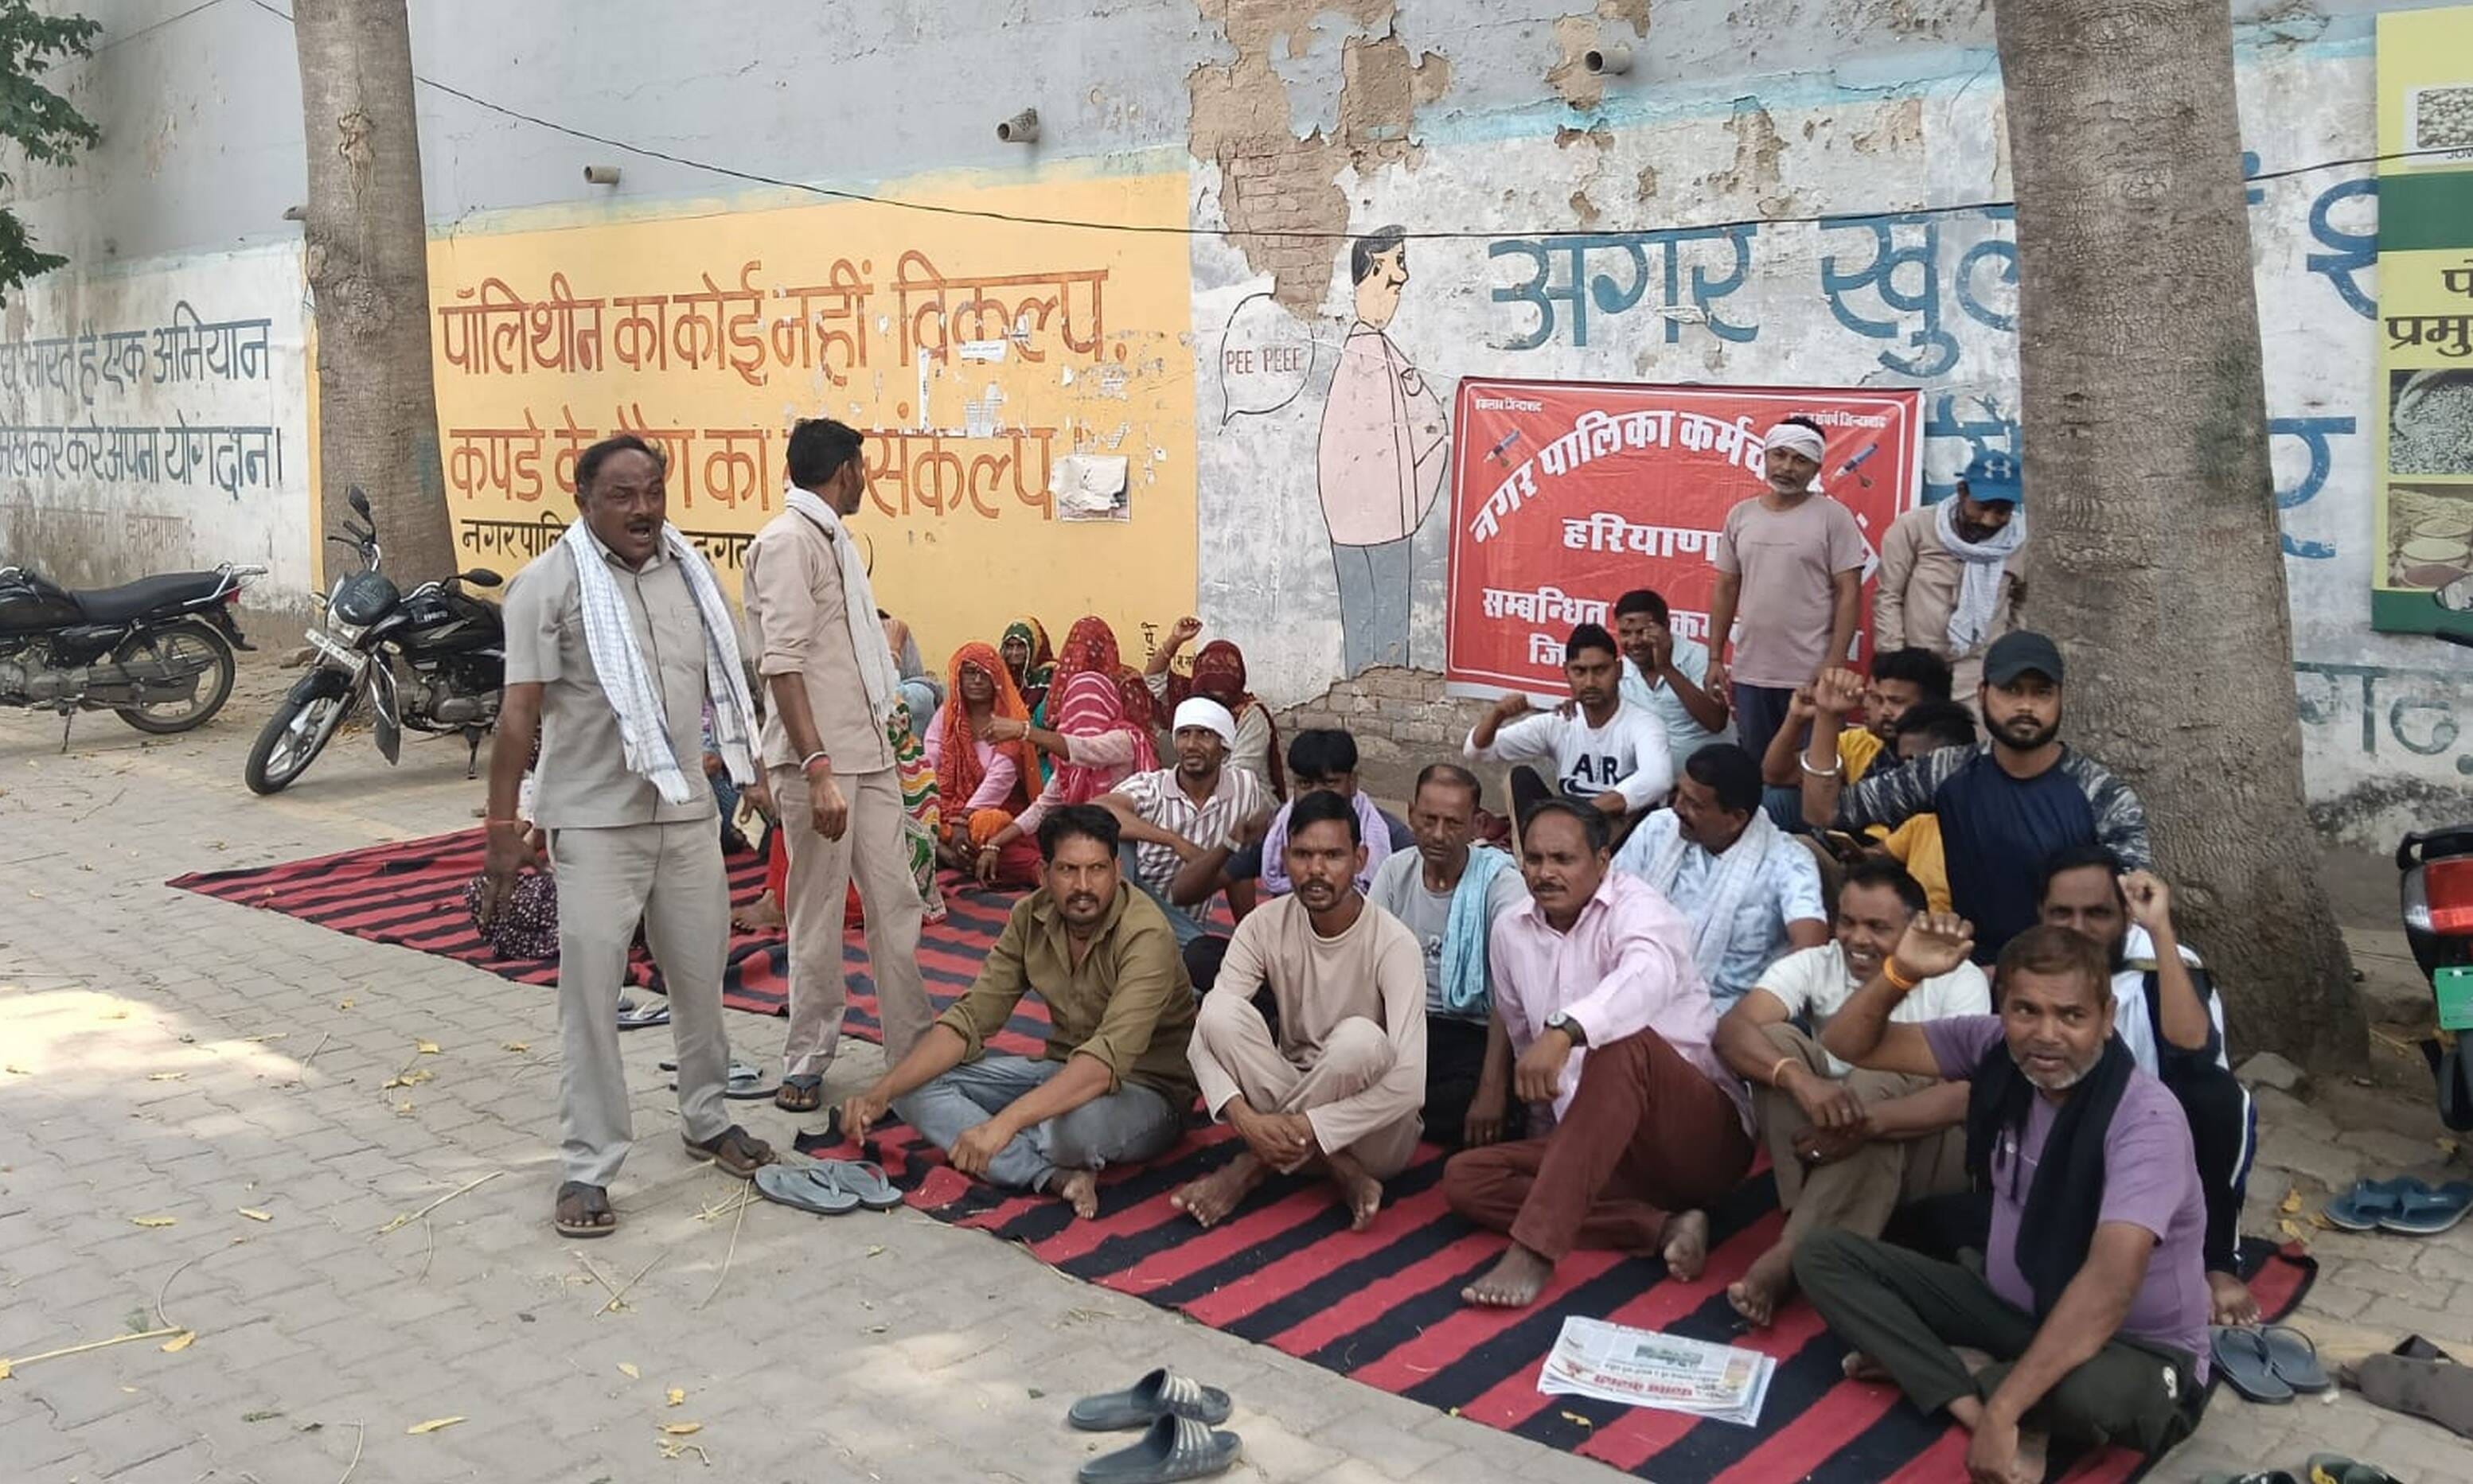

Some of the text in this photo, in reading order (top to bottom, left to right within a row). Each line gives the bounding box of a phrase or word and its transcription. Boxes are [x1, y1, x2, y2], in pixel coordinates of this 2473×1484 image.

[1488, 223, 1759, 350] अगर
[613, 294, 668, 371] का
[673, 260, 770, 387] कोई
[2385, 315, 2473, 357] प्रमु
[102, 330, 146, 395] एक
[1226, 350, 1254, 374] PEE
[104, 426, 159, 482] अपना
[704, 430, 771, 511] का
[1469, 410, 1765, 543] नगर पालिका कर्मच
[1562, 512, 1722, 561] हरियाण
